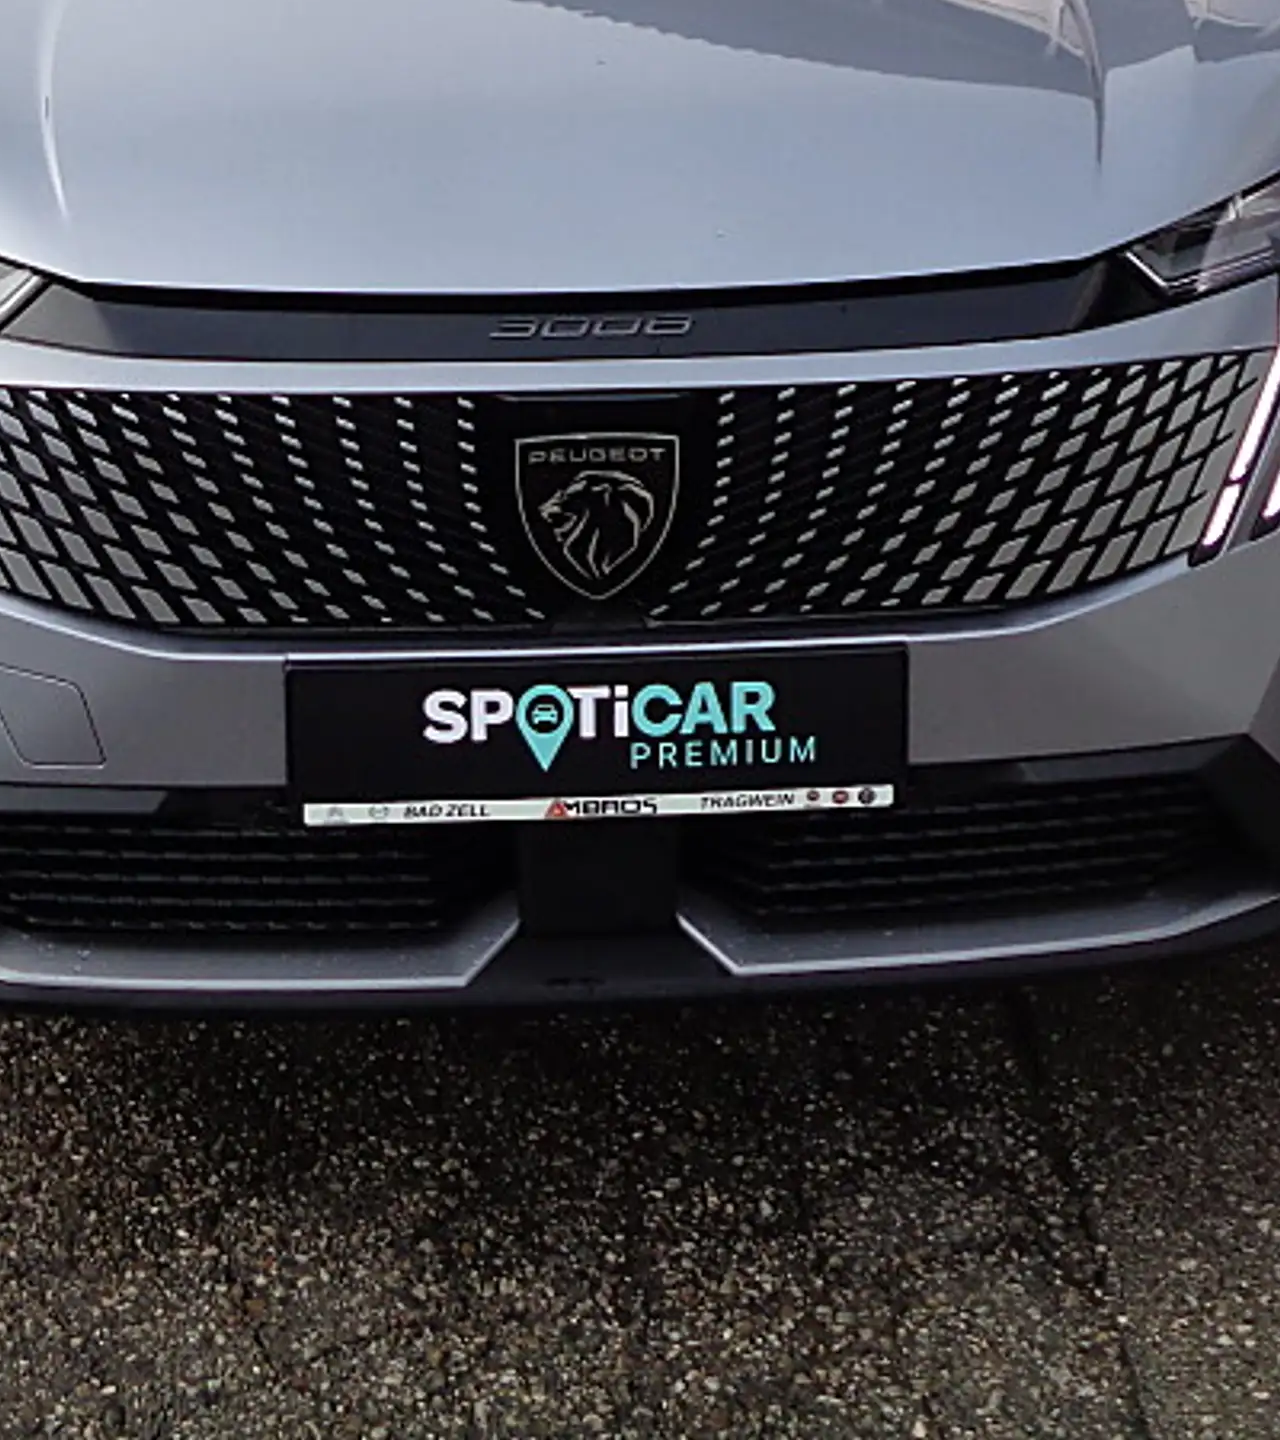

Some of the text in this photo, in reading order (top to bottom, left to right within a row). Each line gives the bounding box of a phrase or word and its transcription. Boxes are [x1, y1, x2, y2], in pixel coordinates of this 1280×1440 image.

[489, 315, 695, 339] 3008
[528, 447, 666, 465] PEUGEOT
[630, 735, 818, 770] PREMIUM
[403, 802, 492, 819] BAD ZELL
[544, 796, 658, 821] AMBROS
[700, 791, 796, 811] TRAGWEIN
